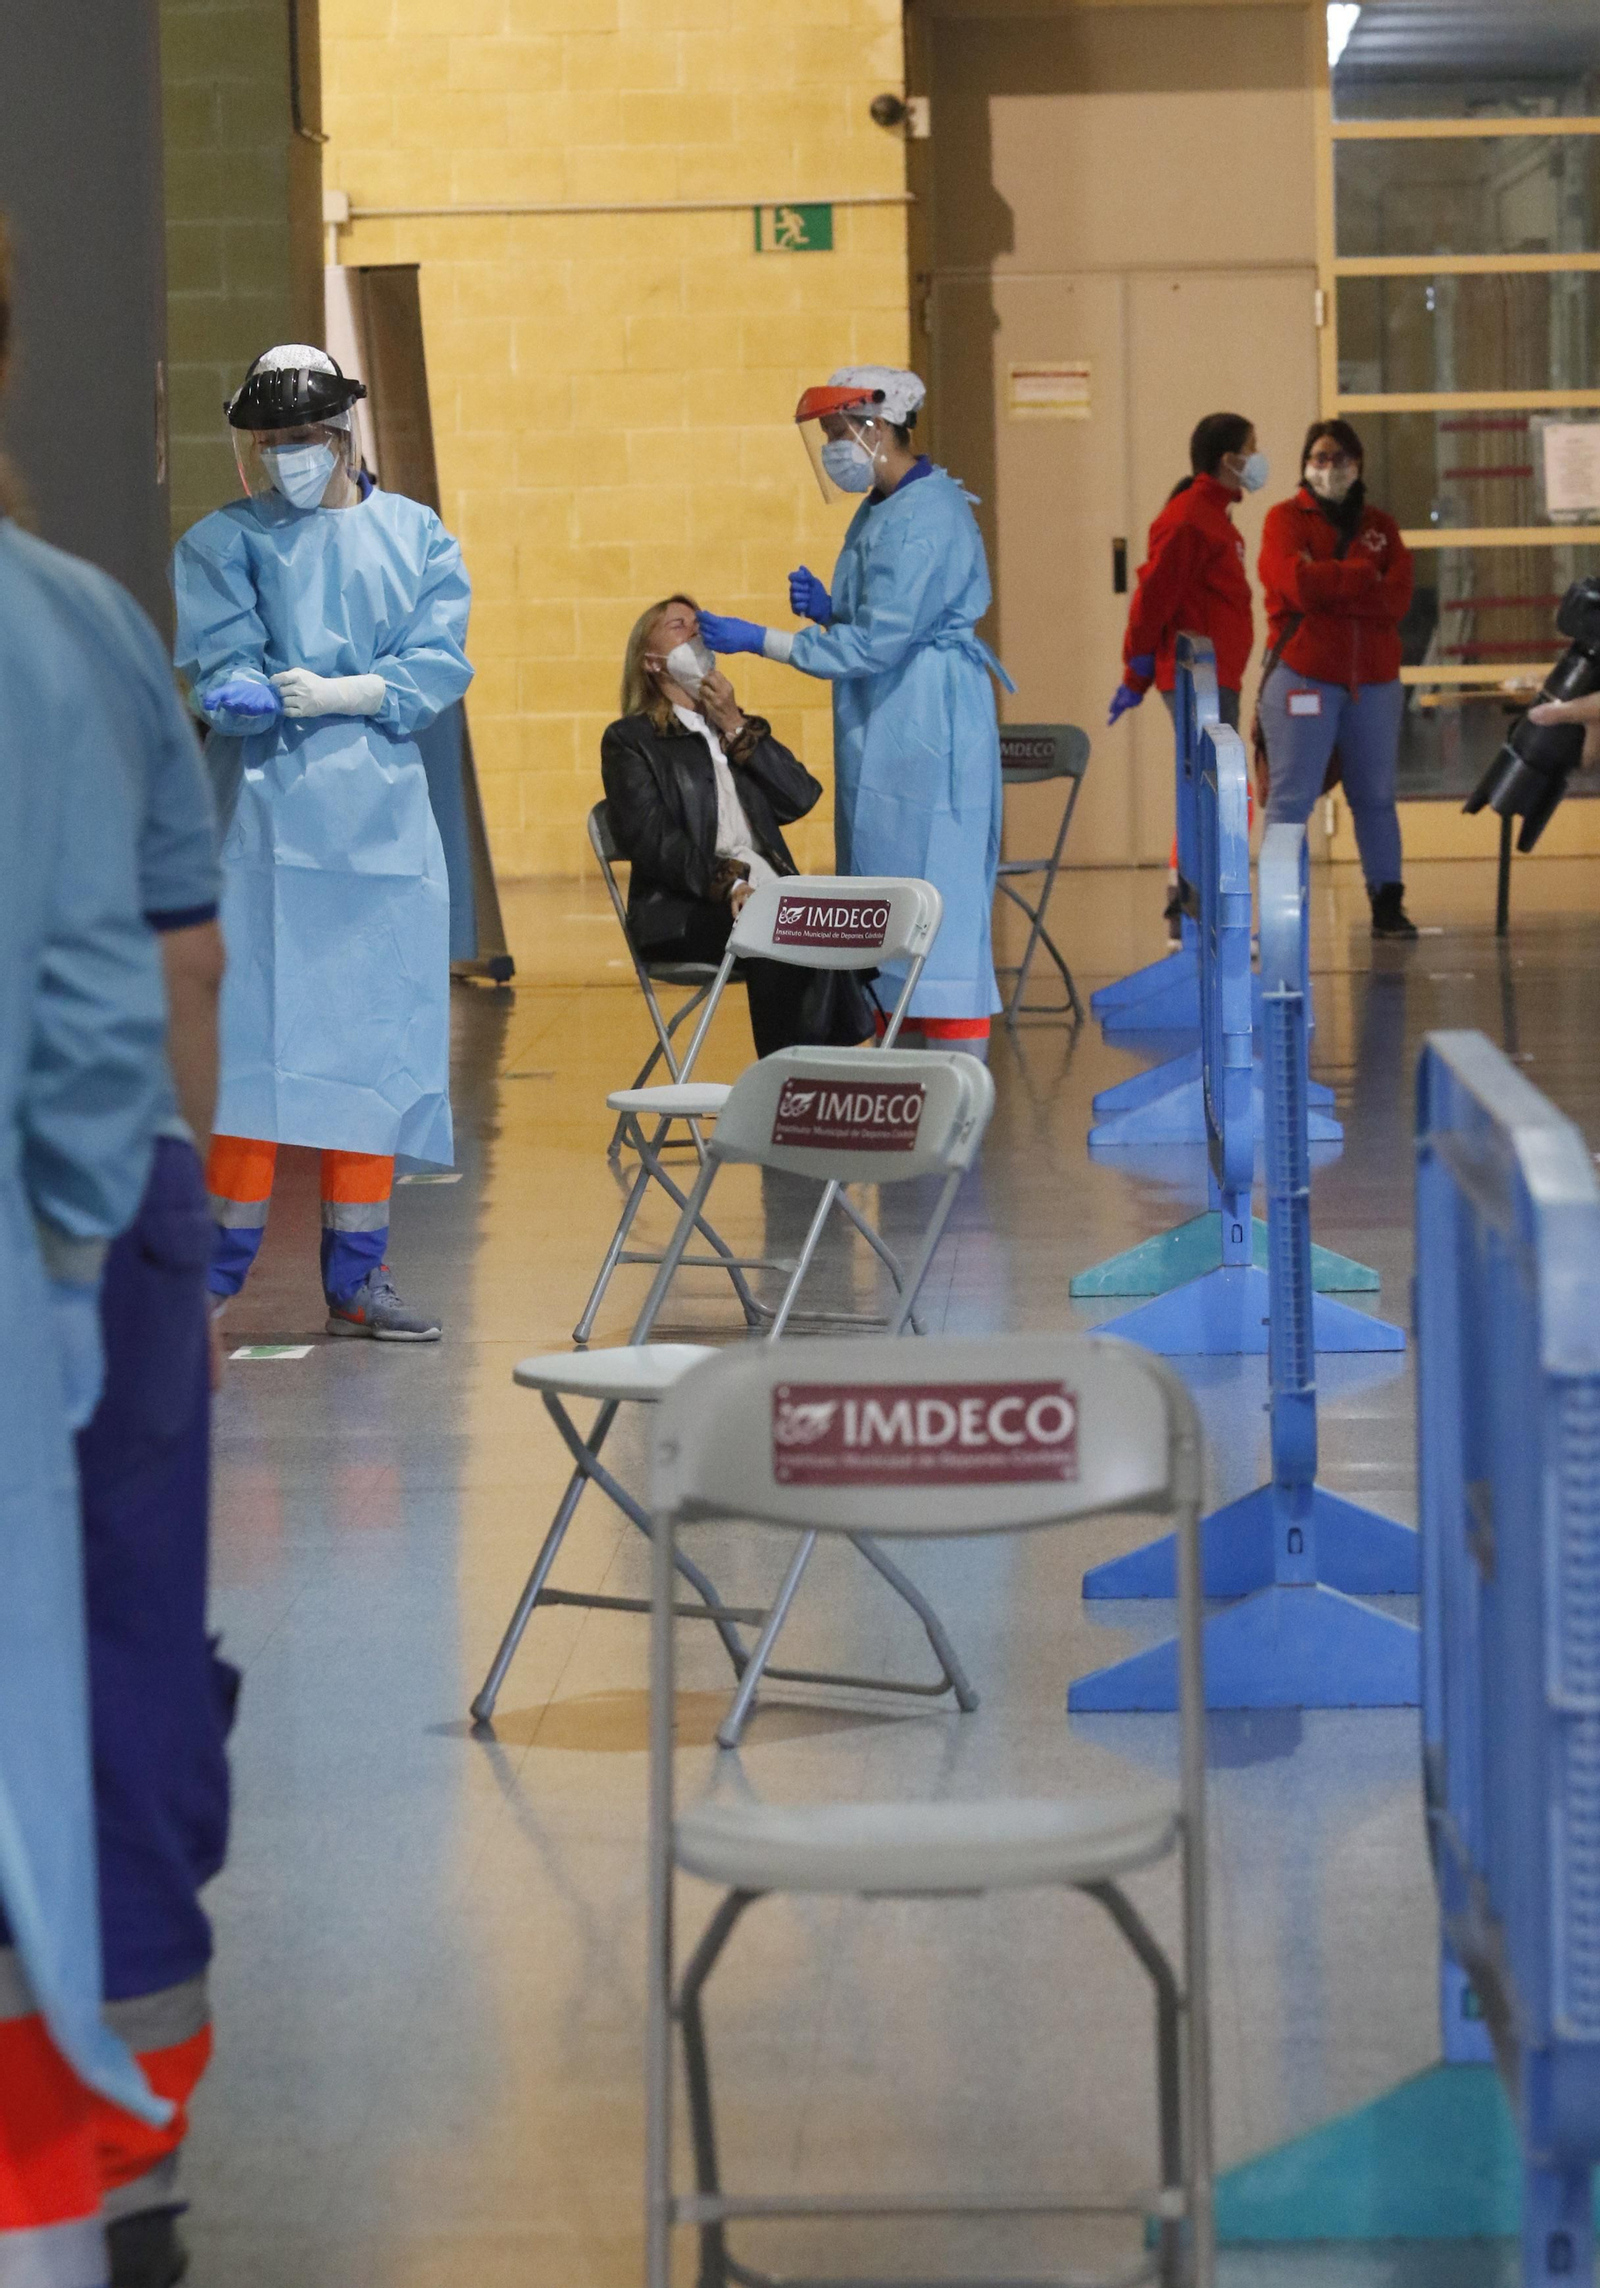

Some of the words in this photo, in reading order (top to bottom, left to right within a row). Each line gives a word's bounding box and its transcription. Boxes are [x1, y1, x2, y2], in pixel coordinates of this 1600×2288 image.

[1000, 742, 1054, 757] MDECO
[805, 906, 888, 928] IMDECO
[803, 930, 831, 939] Municipal
[816, 1091, 921, 1124] IMDECO
[842, 1396, 1075, 1446] IMDECO
